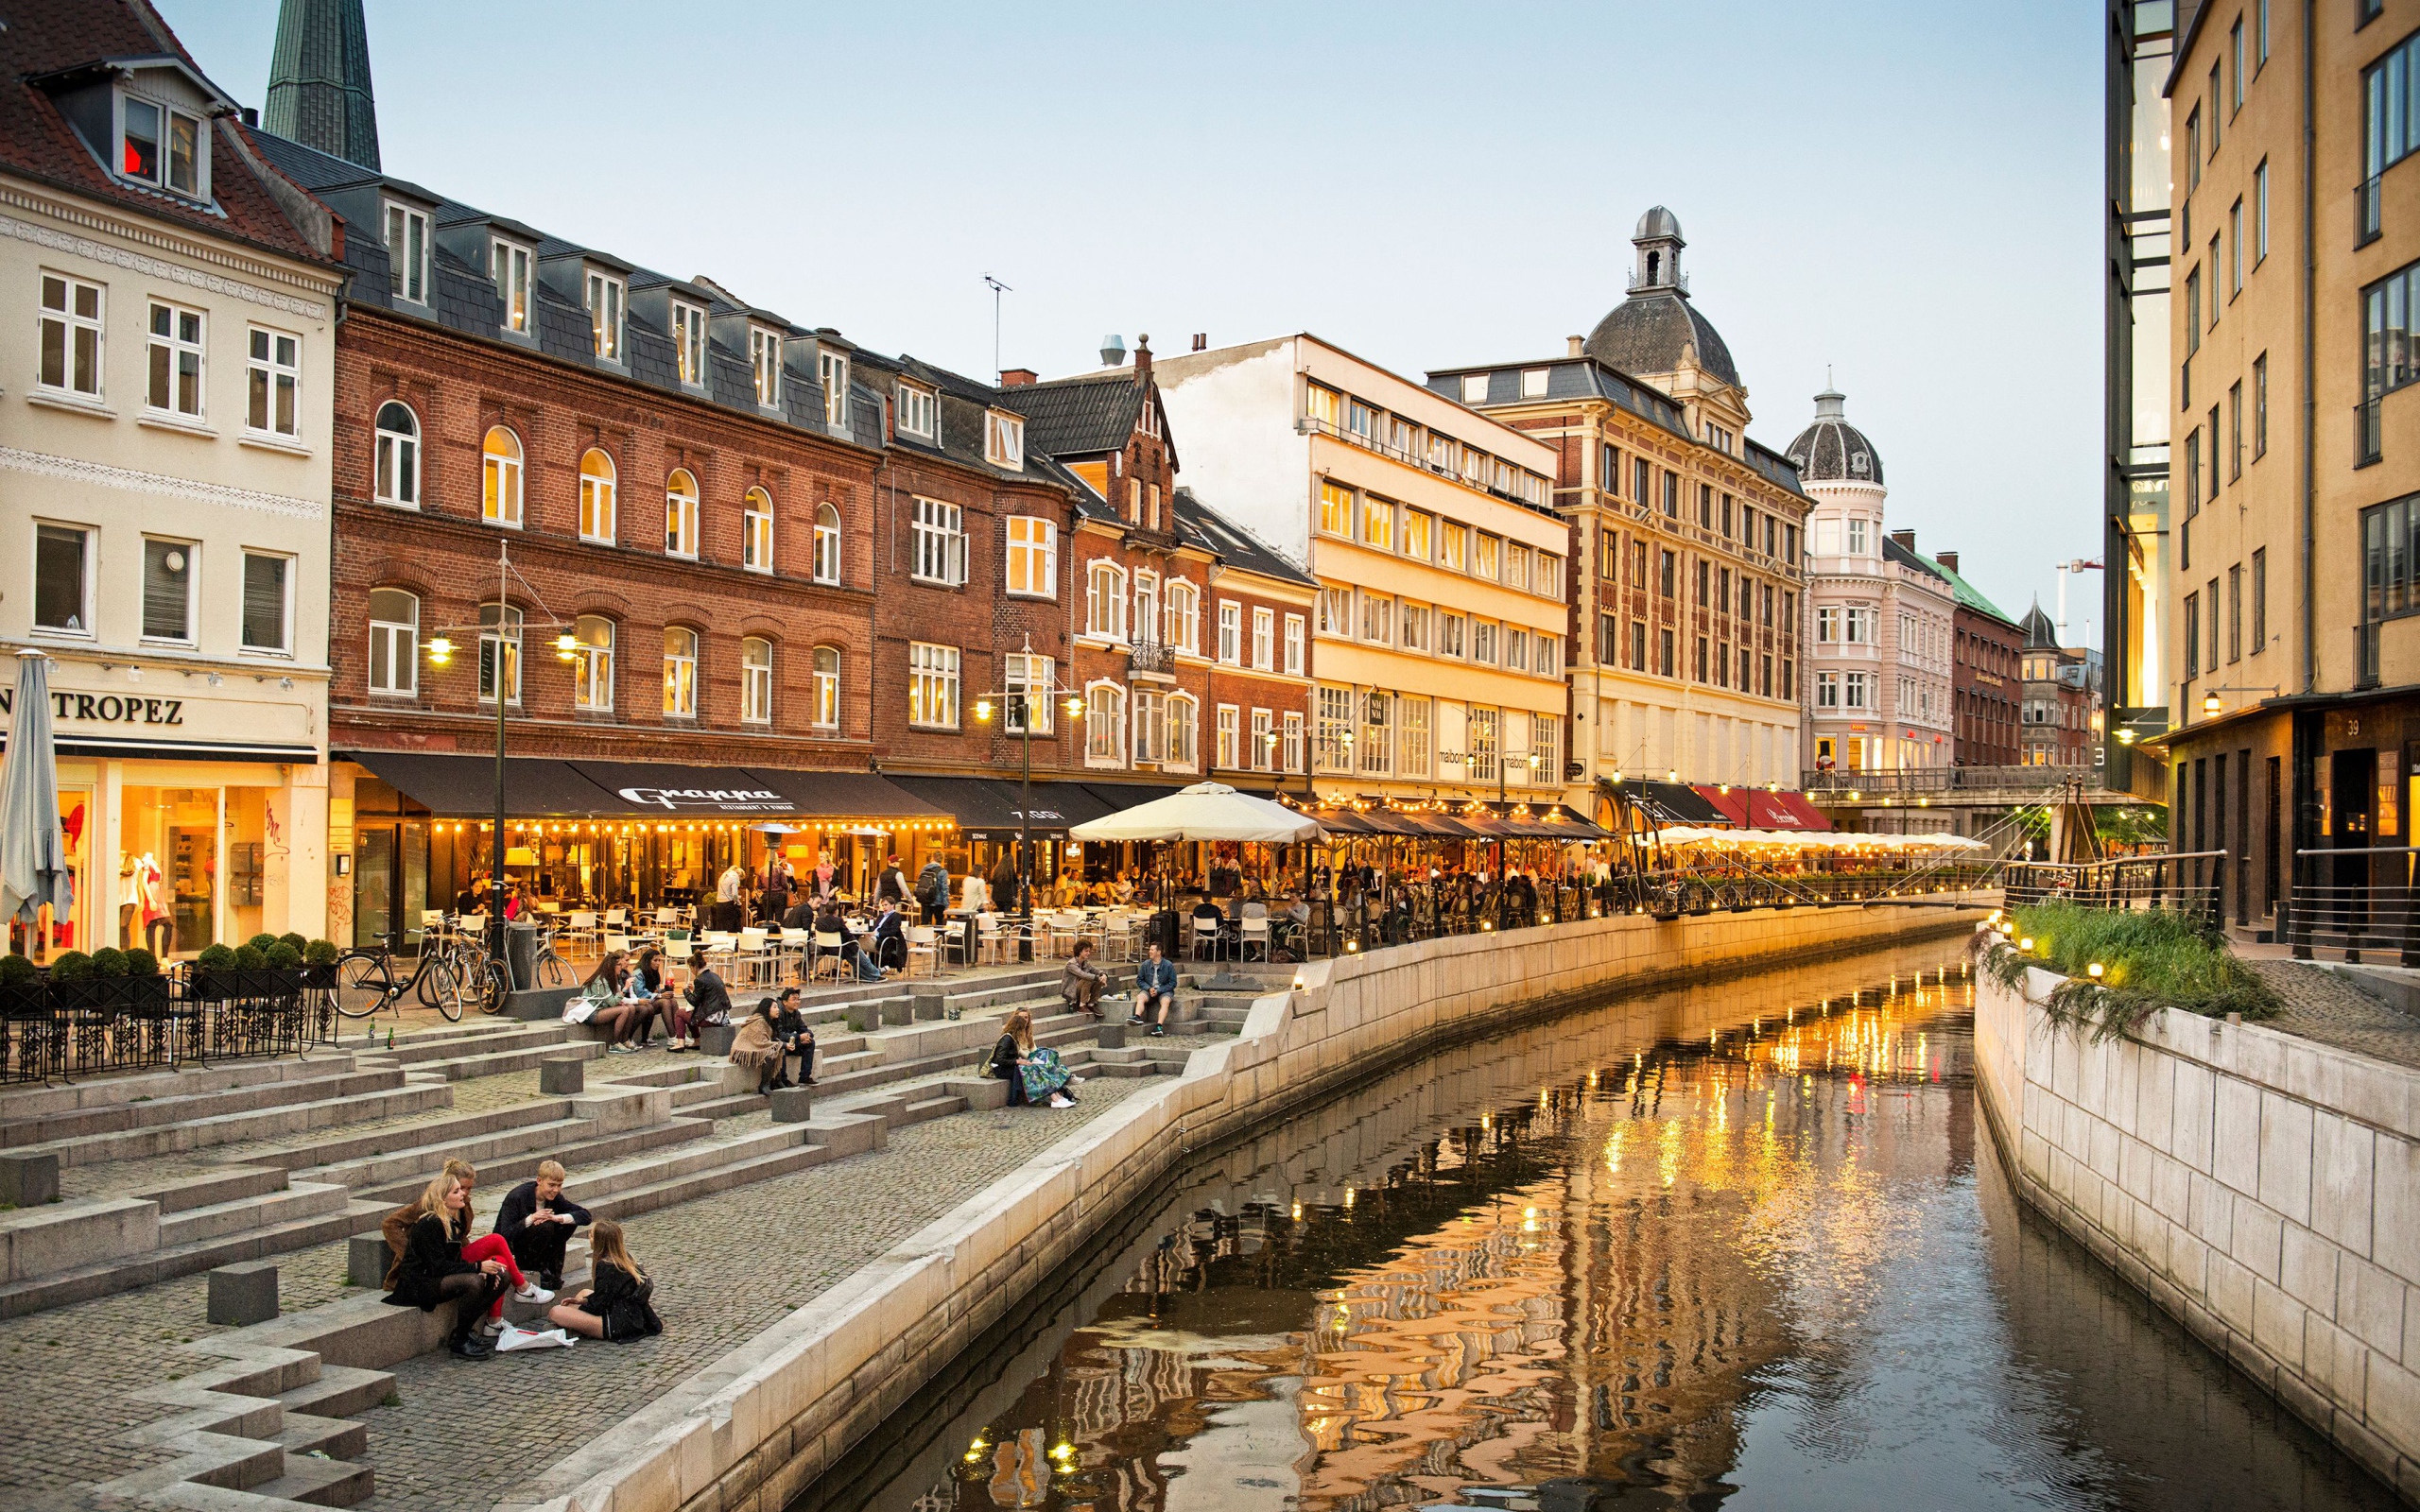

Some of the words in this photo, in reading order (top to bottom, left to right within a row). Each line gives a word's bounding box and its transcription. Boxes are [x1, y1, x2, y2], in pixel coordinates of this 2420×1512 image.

[51, 692, 183, 725] TROPEZ
[2347, 719, 2360, 736] 39
[2094, 747, 2104, 765] 3
[618, 788, 781, 810] Grappa
